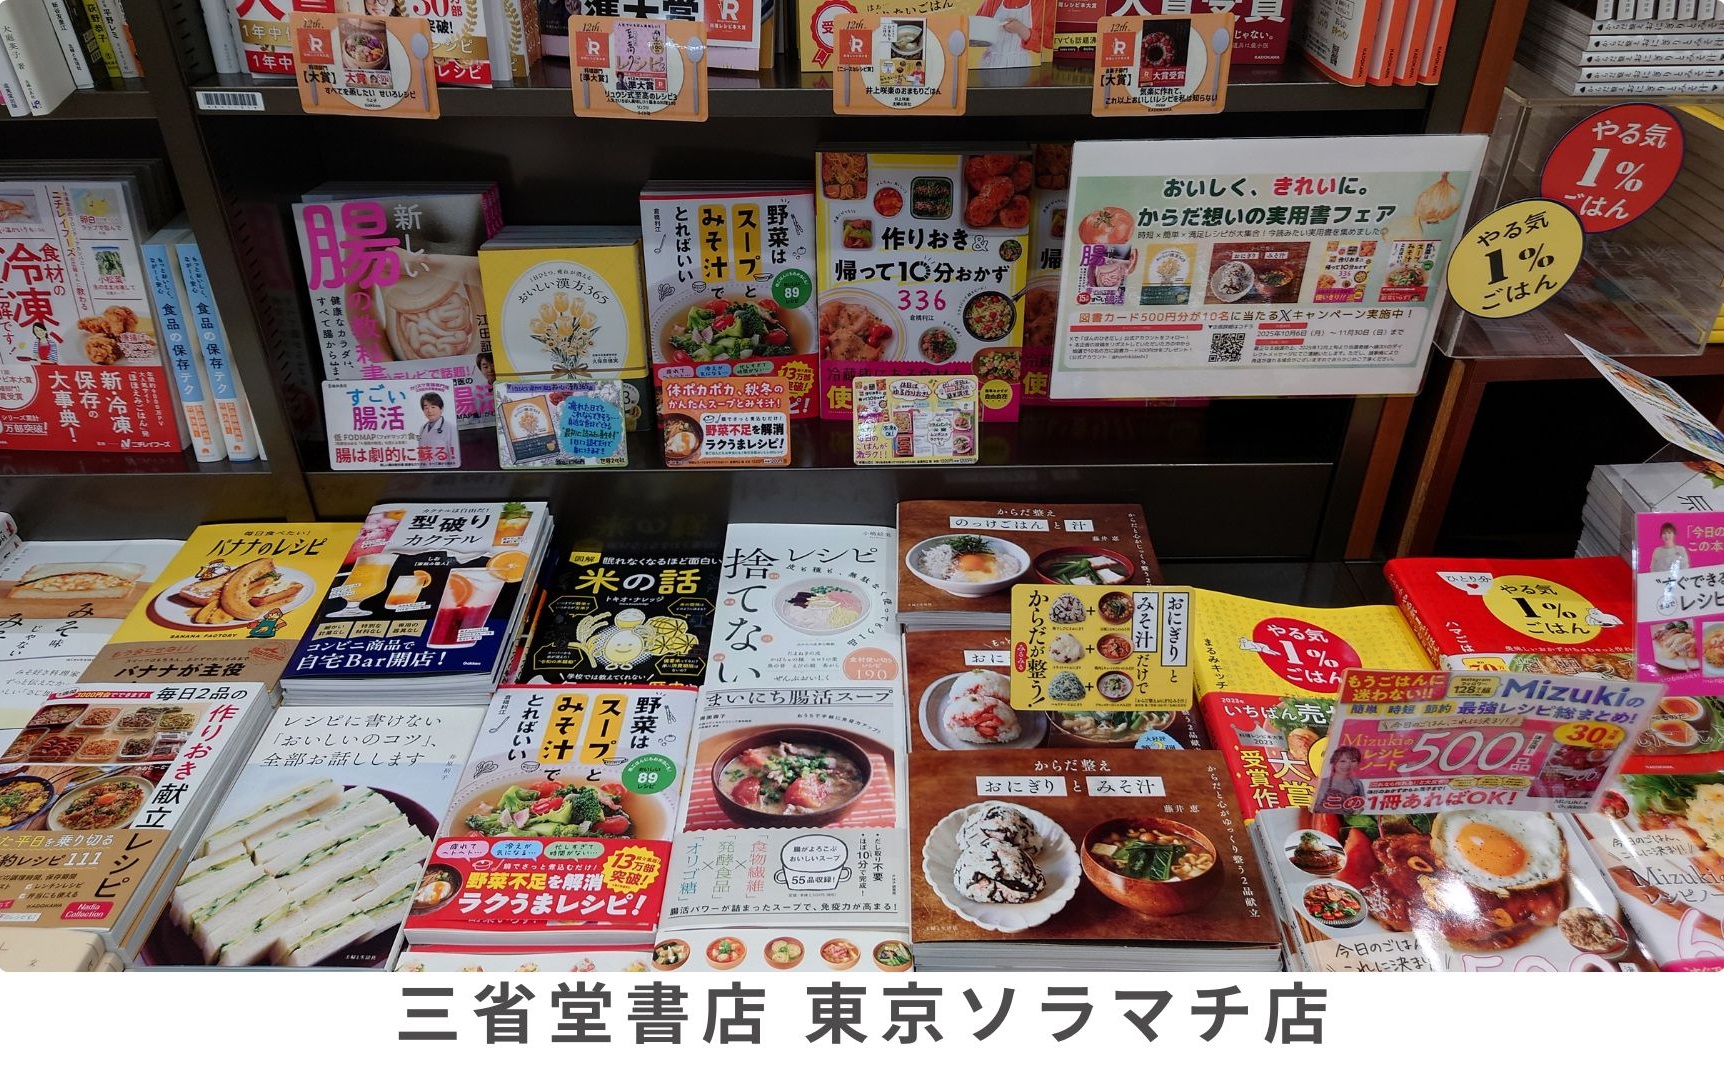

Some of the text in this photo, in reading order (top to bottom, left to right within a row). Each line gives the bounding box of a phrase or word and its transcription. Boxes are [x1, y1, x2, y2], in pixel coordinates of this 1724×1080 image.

[438, 63, 482, 80] レシピ
[1592, 120, 1671, 148] やる気
[1576, 148, 1645, 192] 1%
[1163, 176, 1368, 198] おいしく、きれいに。
[1564, 192, 1629, 219] ごはん
[52, 191, 76, 257] ニチレイフーズ
[1137, 204, 1396, 228] からだ想いの実用書フェア
[767, 204, 789, 265] 野菜は
[882, 226, 989, 252] 作りおき&
[1477, 211, 1548, 247] やる気
[394, 204, 430, 278] 新しい
[675, 206, 694, 283] とればいい
[39, 242, 66, 296] 食材の
[835, 257, 1011, 283] 帰って10分おかず
[1485, 243, 1554, 285] 1%
[518, 277, 610, 305] おいしい漢方365
[784, 287, 800, 298] 89
[897, 289, 947, 311] 336
[1481, 275, 1558, 310] ごはん
[161, 303, 194, 395] 食品の保存テク
[196, 303, 229, 394] 食品の保存テク
[667, 383, 784, 397] 体ポカポカ、秋冬の
[1023, 372, 1049, 395] 使
[75, 371, 101, 419] 保存の
[347, 384, 406, 406] すごい
[668, 399, 781, 409] かんたんスープとみそ汁!
[48, 371, 81, 443] 大事典!
[353, 405, 405, 431] 腸活
[705, 423, 784, 436] 野菜不足を解消
[336, 446, 455, 463] 腸は劇的に蘇る!
[705, 439, 785, 450] ラクうまレシピ!
[997, 508, 1056, 518] からだ整え
[408, 514, 491, 533] 型破り
[955, 518, 1086, 531] のっけごはん と 汁
[207, 537, 328, 556] バナナのレシピ
[403, 535, 483, 548] カクテル
[602, 556, 724, 566] 眠れなくなるほど面白い
[788, 547, 878, 564] レシピ
[575, 567, 702, 594] 米の話
[1446, 574, 1492, 584] ひとり分
[1501, 584, 1558, 596] やる気
[713, 547, 780, 684] 捨てない
[1512, 597, 1577, 619] 1%
[1267, 624, 1329, 643] やる気
[1527, 622, 1590, 635] ごはん
[307, 640, 416, 652] コンビニ商品で
[1028, 590, 1049, 708] からだが整う!
[1279, 640, 1339, 668] 1%
[297, 651, 448, 671] 自宅Bar開店!
[1017, 643, 1026, 672] みるみる
[115, 663, 246, 678] バナナが主役
[1350, 675, 1444, 688] もうごはんに
[156, 687, 248, 701] 毎日2品の
[706, 689, 894, 708] まいにち腸活スープ
[1352, 689, 1433, 701] 迷わない!!
[1502, 678, 1645, 708] Mizukiの
[285, 713, 443, 728] レシピに書けない
[630, 697, 662, 749] 野菜は
[1351, 702, 1636, 724] 簡単 時短 節約 最強レシピ総まとめ!
[508, 695, 545, 761] とればいい
[273, 733, 437, 748] 「おいしいのコツ」、
[1342, 733, 1414, 747] Mizukiの
[260, 752, 426, 767] 全部お話しします
[1364, 750, 1405, 759] レシピ
[1397, 730, 1525, 773] 500
[1034, 759, 1111, 773] からだ整え
[1360, 762, 1397, 771] ノート
[1510, 757, 1530, 772] 品
[637, 773, 658, 784] 89
[985, 780, 1155, 794] おにぎり と みそ汁
[1240, 750, 1281, 808] 受賞作
[1268, 752, 1316, 809] 大賞
[1164, 804, 1200, 813] 藤井 恵
[1323, 790, 1518, 810] この1冊あればOK!
[1207, 765, 1262, 919] からだと心がゆっくり整う2品献立
[612, 853, 656, 873] 13万部
[789, 855, 840, 863] おいしいスープ
[465, 872, 604, 891] 野菜不足を解消
[613, 870, 650, 886] 突破!
[791, 876, 836, 885] 55品収録!
[65, 910, 104, 918] Collection
[458, 893, 647, 916] ラクうまレシピ!
[669, 902, 898, 917] 腸活パワーが詰まったスープで、免疫力が高まる!
